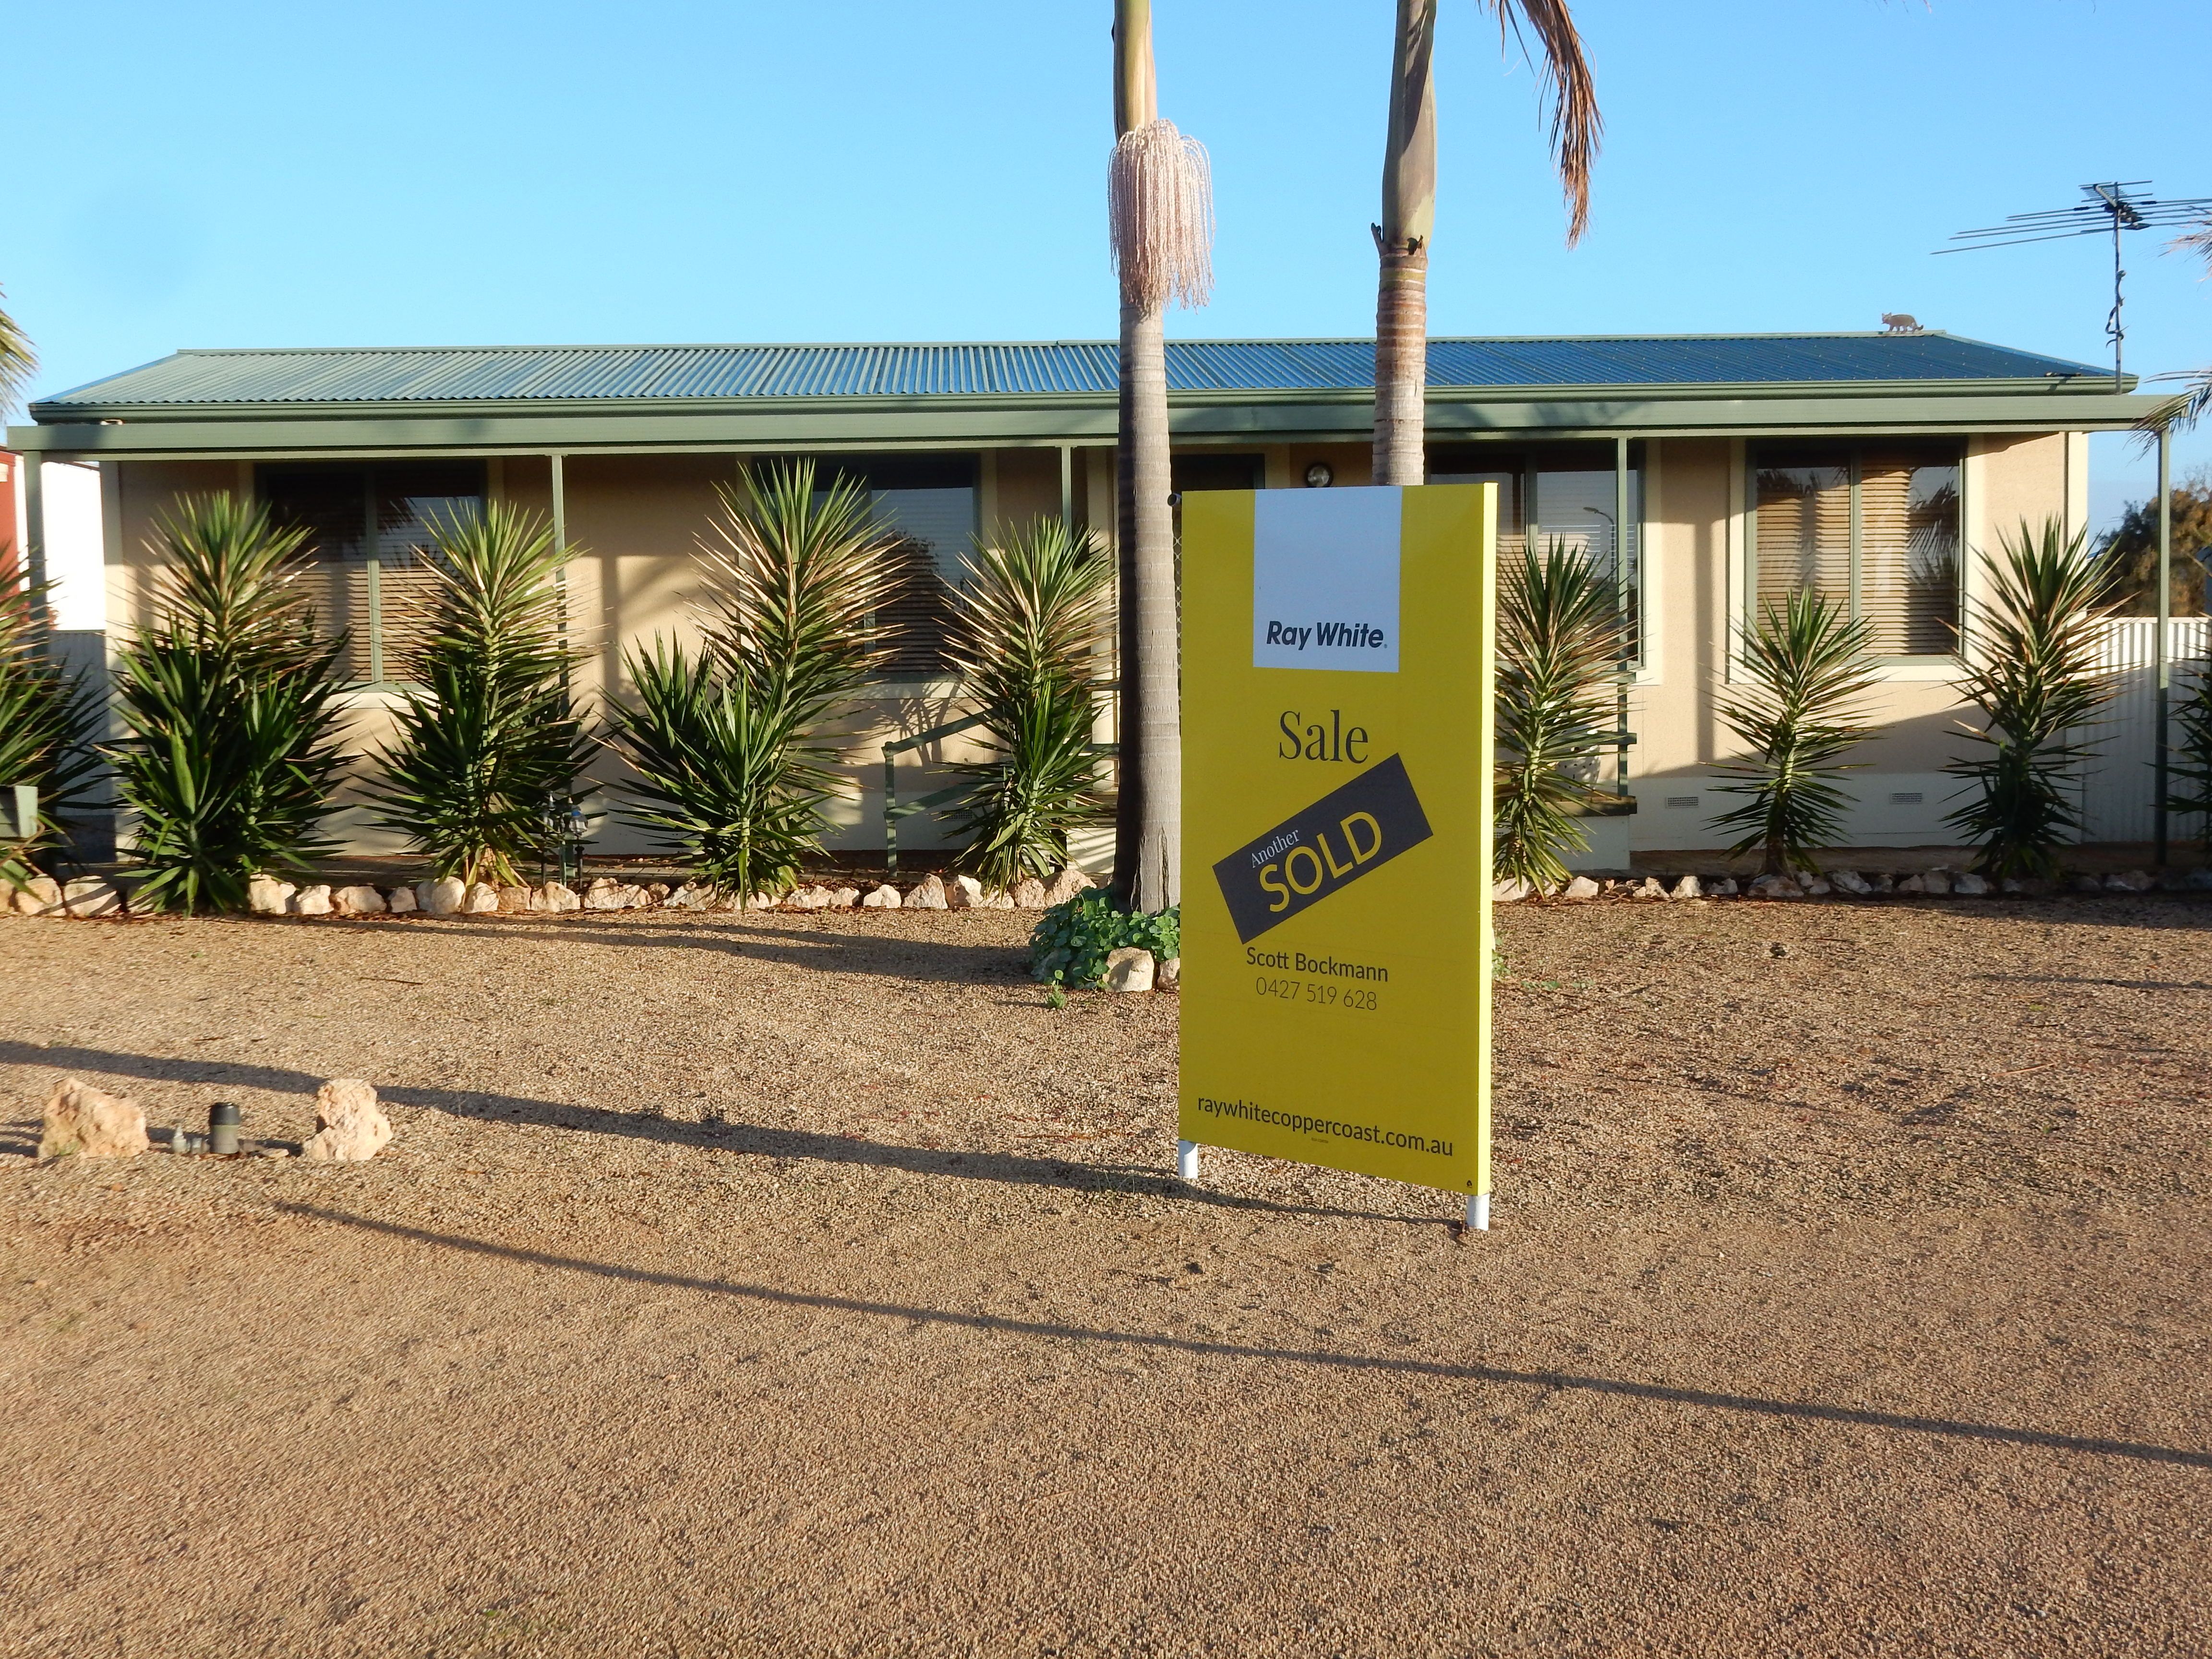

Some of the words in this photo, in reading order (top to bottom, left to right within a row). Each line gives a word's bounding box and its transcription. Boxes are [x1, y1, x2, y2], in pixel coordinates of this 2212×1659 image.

[1266, 621, 1312, 650] Ray
[1279, 709, 1369, 764] Sale
[1251, 830, 1300, 868] Another
[1259, 811, 1382, 912] SOLD
[1247, 946, 1289, 970] Scott
[1296, 952, 1388, 982] Bockmann
[1256, 976, 1300, 1000] 0427
[1307, 984, 1337, 1005] 519
[1343, 989, 1377, 1010] 628
[1198, 1096, 1453, 1157] raywhitecoppercoast.com.au
